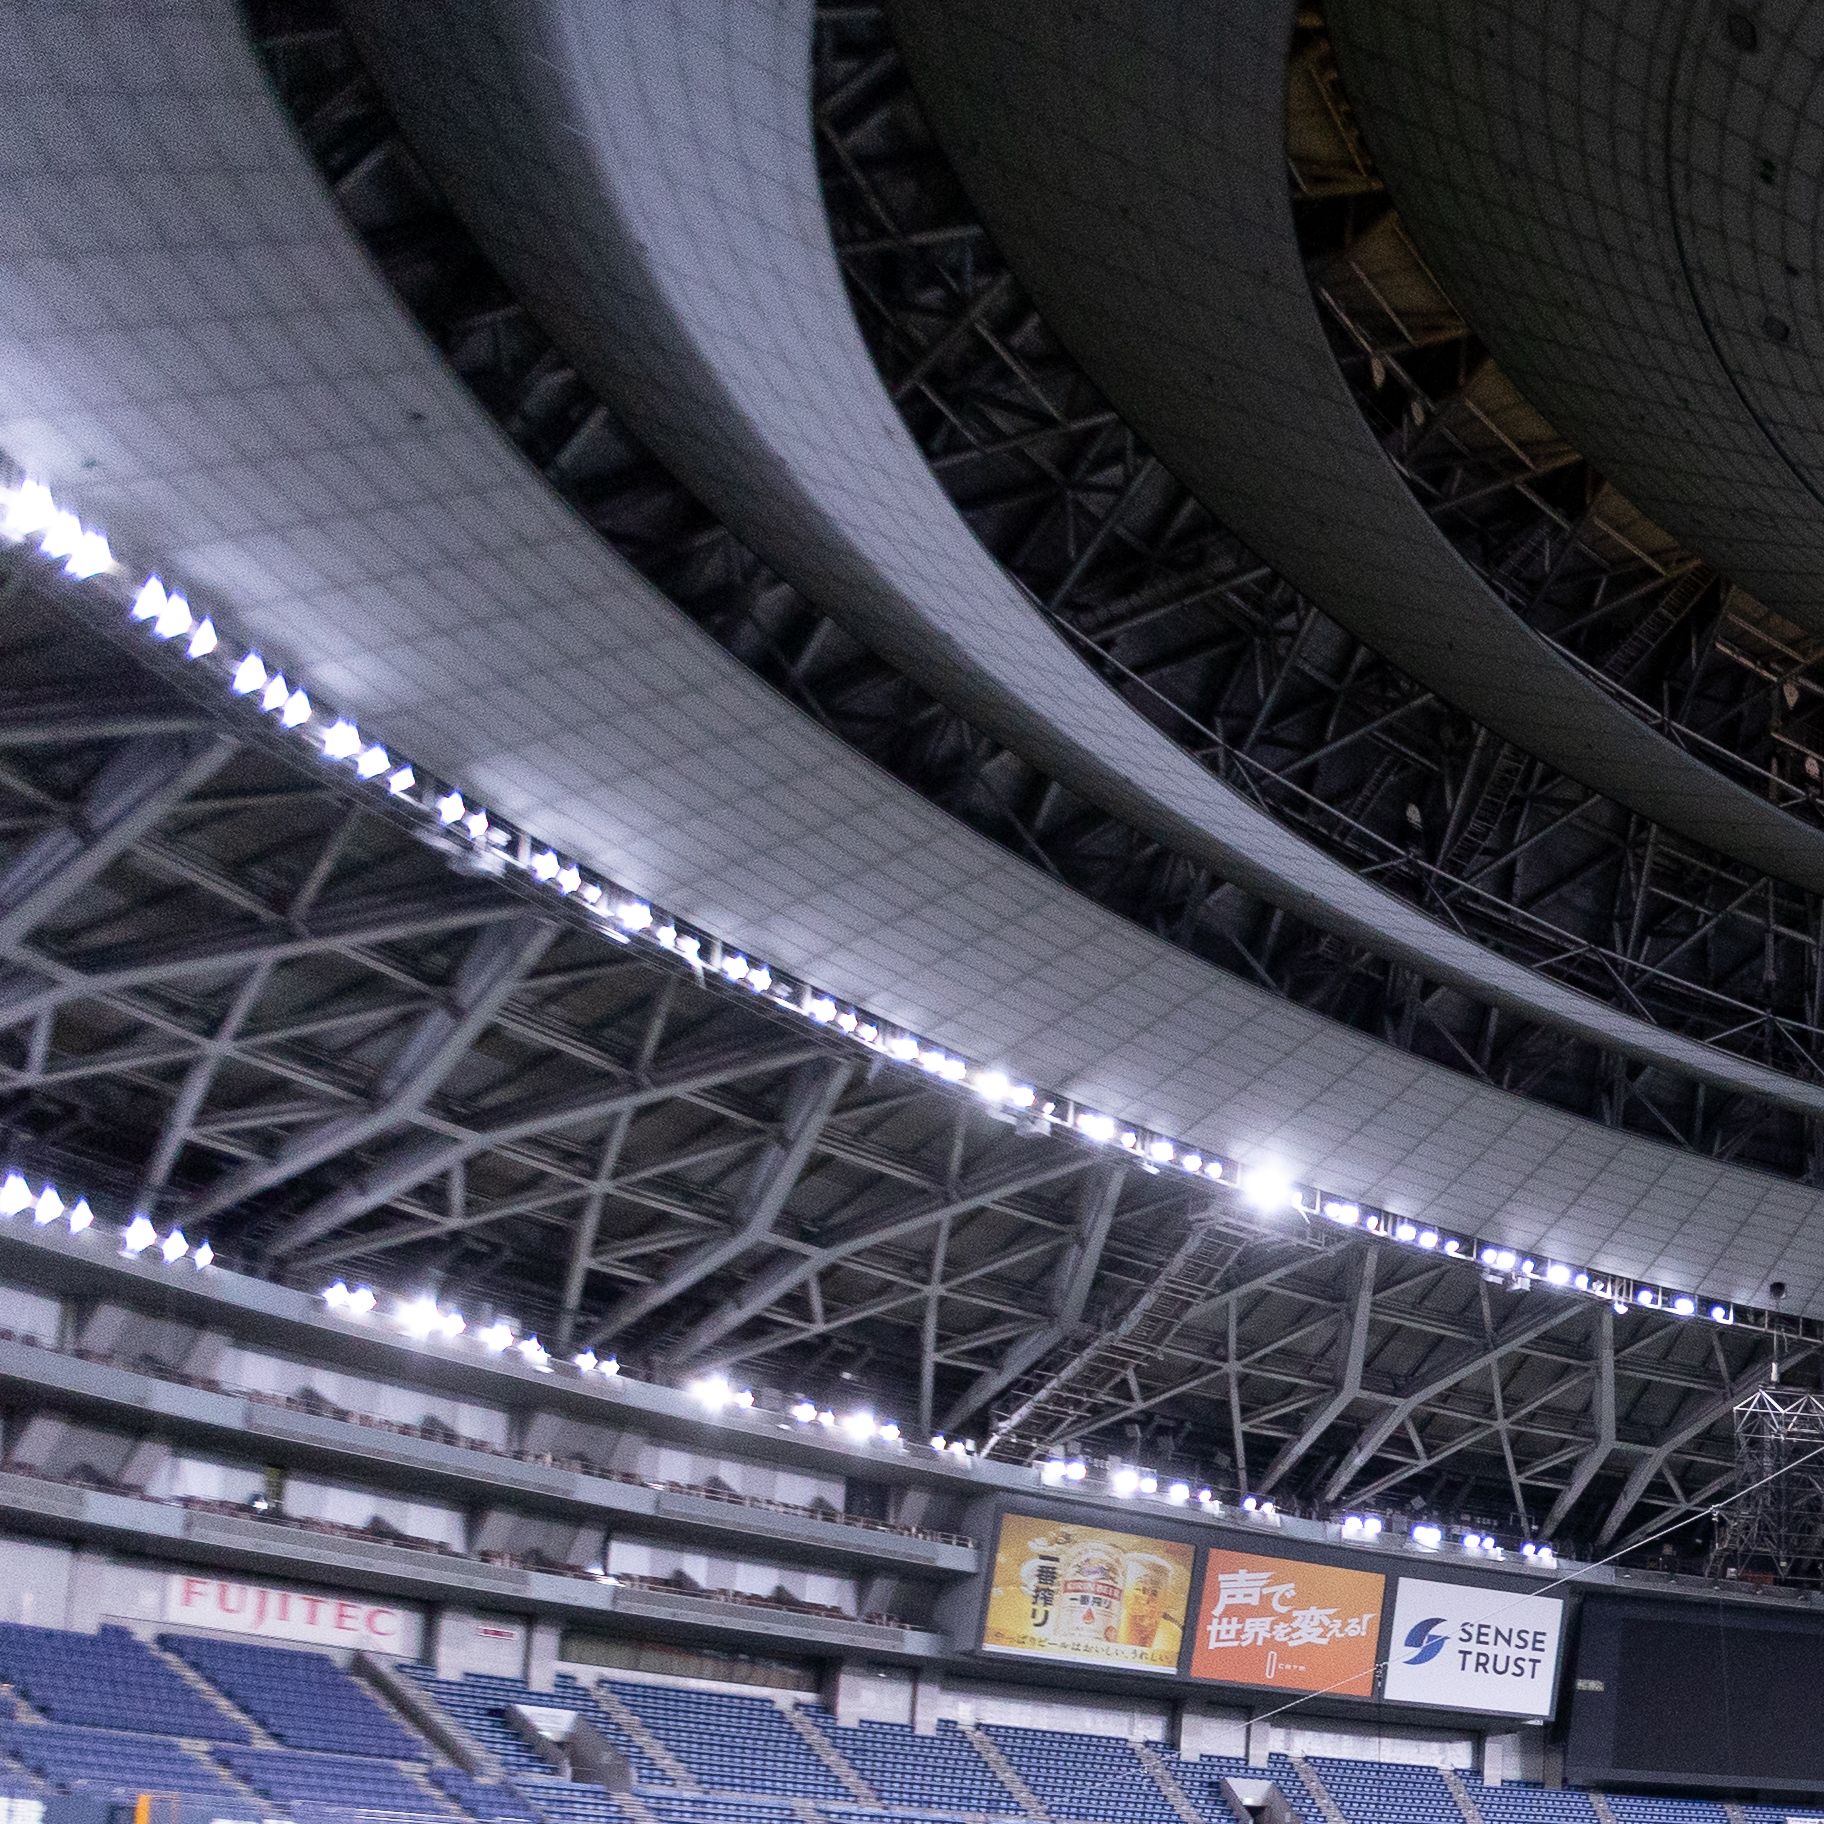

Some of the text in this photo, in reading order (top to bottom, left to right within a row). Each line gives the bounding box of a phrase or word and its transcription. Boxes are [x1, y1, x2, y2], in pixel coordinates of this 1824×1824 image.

[181, 1576, 397, 1636] FUJITEC
[1031, 1555, 1060, 1627] 一番搾り
[1211, 1569, 1297, 1617] 声で
[1458, 1623, 1547, 1653] SENSE
[1457, 1649, 1543, 1680] TRUST
